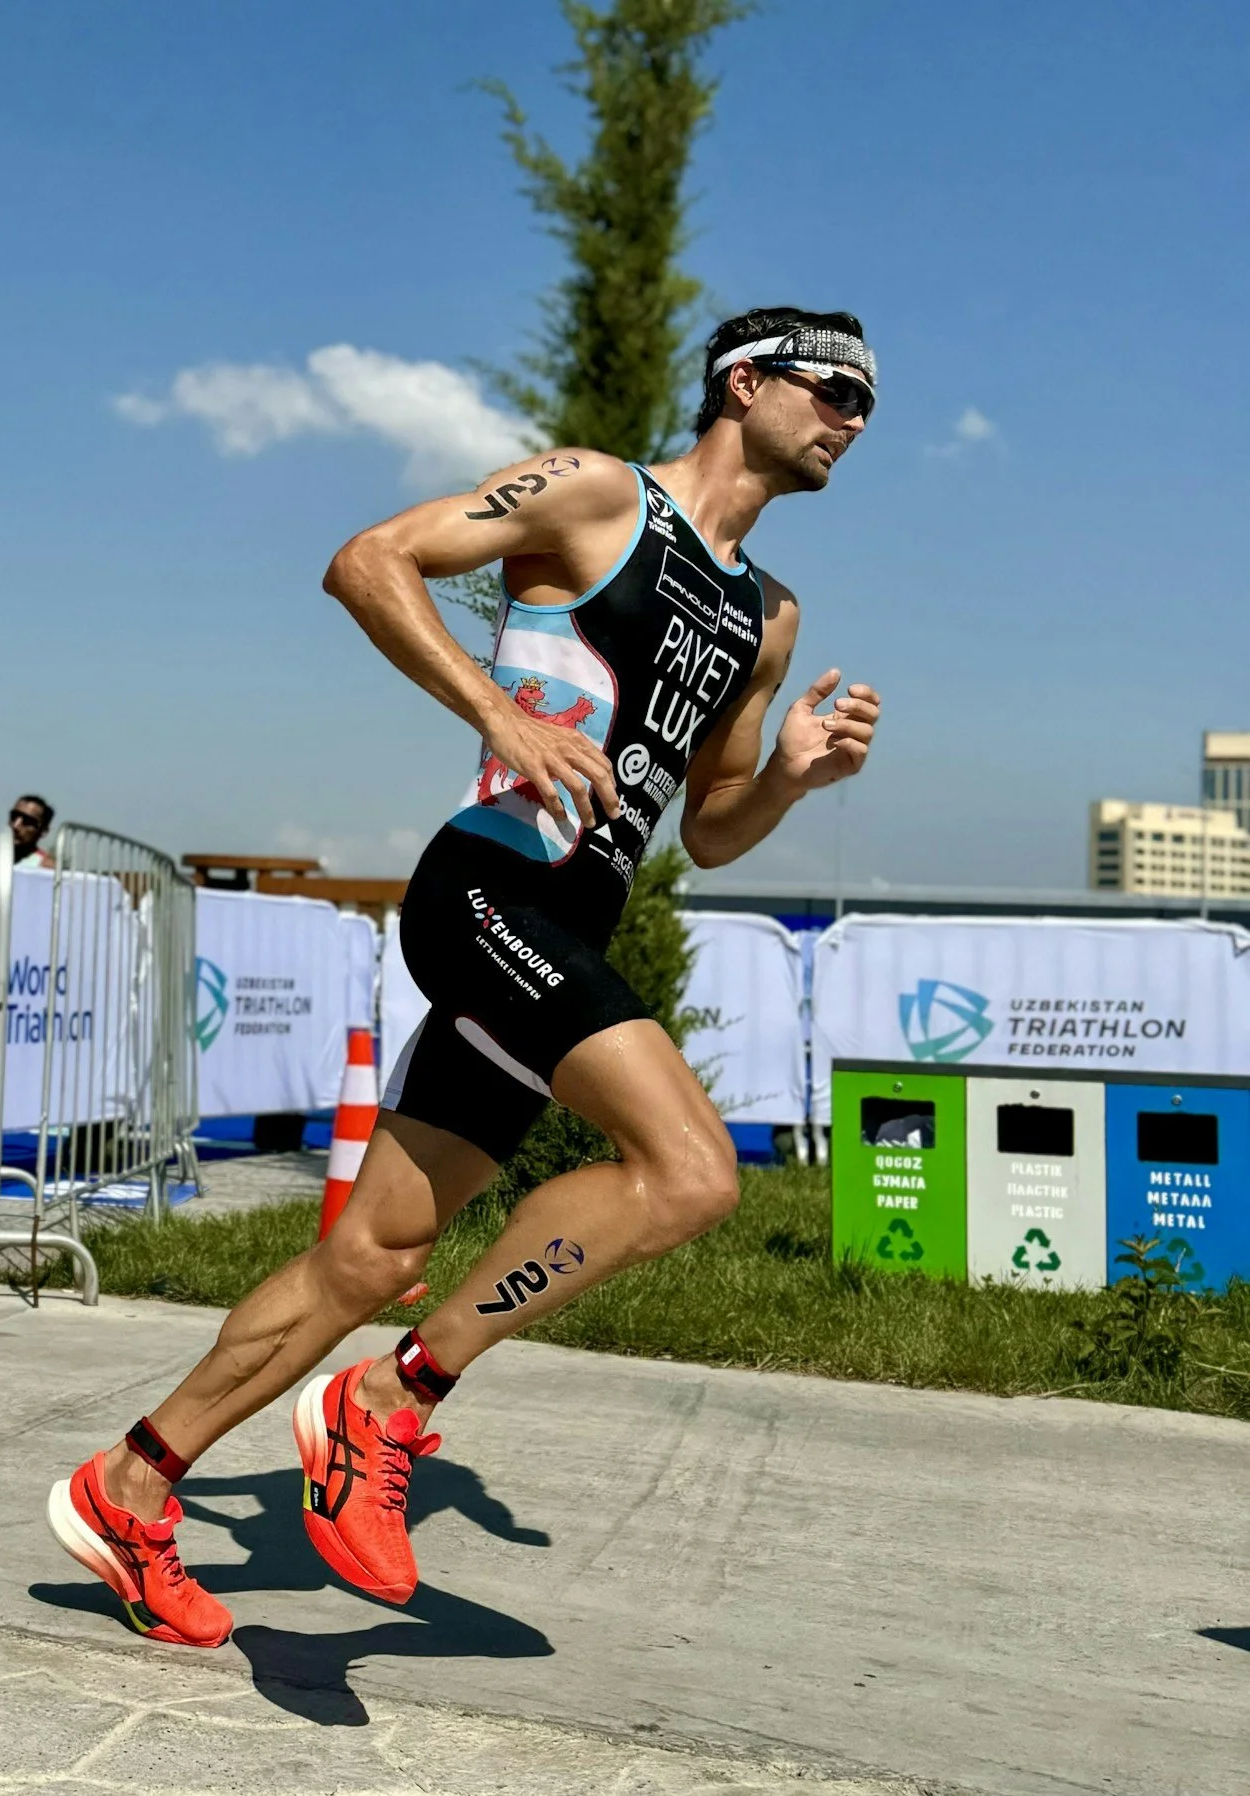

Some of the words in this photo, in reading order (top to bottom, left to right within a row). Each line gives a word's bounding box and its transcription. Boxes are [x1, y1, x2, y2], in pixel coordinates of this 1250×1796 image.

[723, 601, 752, 627] Atelier
[653, 614, 740, 709] PAYET
[644, 679, 706, 759] LUX
[618, 793, 650, 844] balois
[490, 951, 510, 971] MAKE
[507, 967, 517, 977] IT
[7, 956, 68, 996] Word
[234, 995, 312, 1016] TRIATHLON
[1010, 999, 1144, 1013] UZBEKISTAN
[6, 1003, 93, 1045] Triathon
[1008, 1018, 1186, 1039] TRIATHLON
[1008, 1043, 1136, 1057] FEDERATION
[1011, 1162, 1063, 1177] PLASTIK
[1150, 1171, 1211, 1188] METALL
[873, 1174, 926, 1190] БУМАГА
[876, 1194, 919, 1210] PAPER
[1147, 1191, 1212, 1208] МЕТАЛЛ
[1153, 1212, 1206, 1229] METAL
